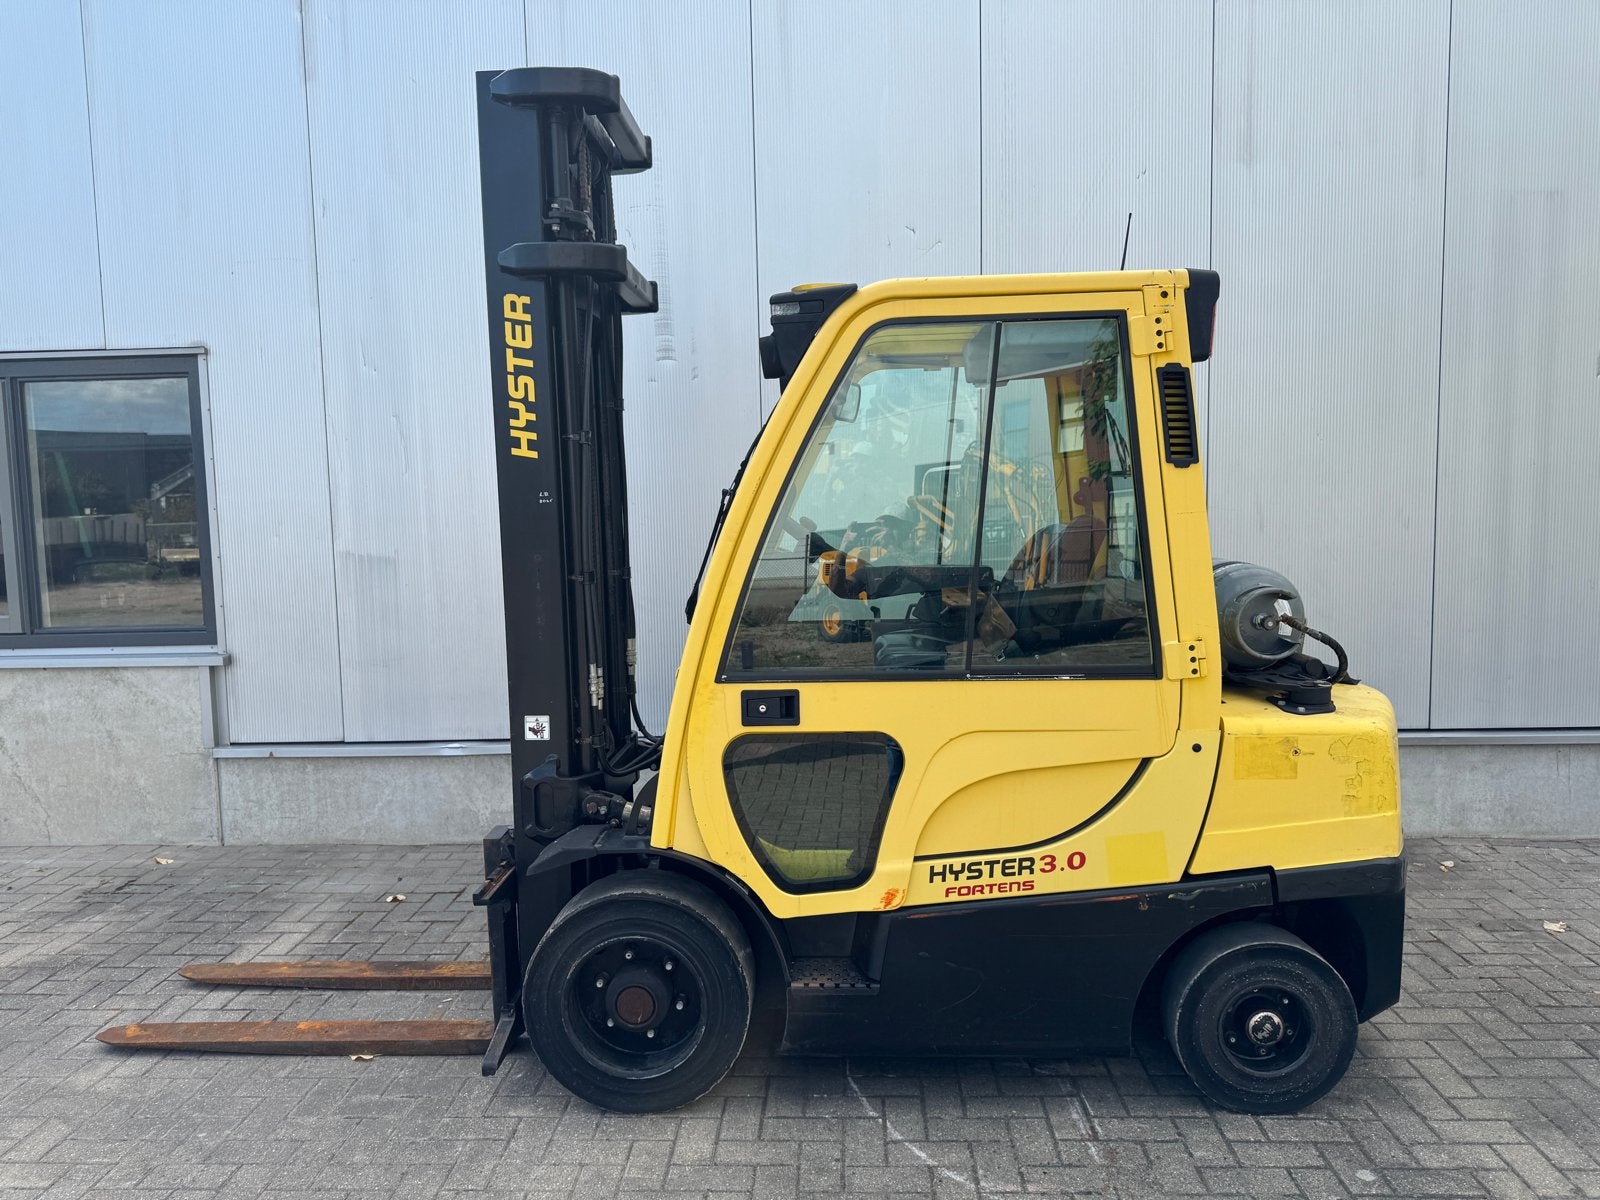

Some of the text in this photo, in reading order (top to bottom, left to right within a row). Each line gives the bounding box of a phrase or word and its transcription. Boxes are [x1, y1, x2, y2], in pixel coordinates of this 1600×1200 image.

[503, 293, 539, 459] HYSTER
[929, 851, 1087, 883] HYSTER 3.0
[945, 880, 1035, 897] FORTENS
